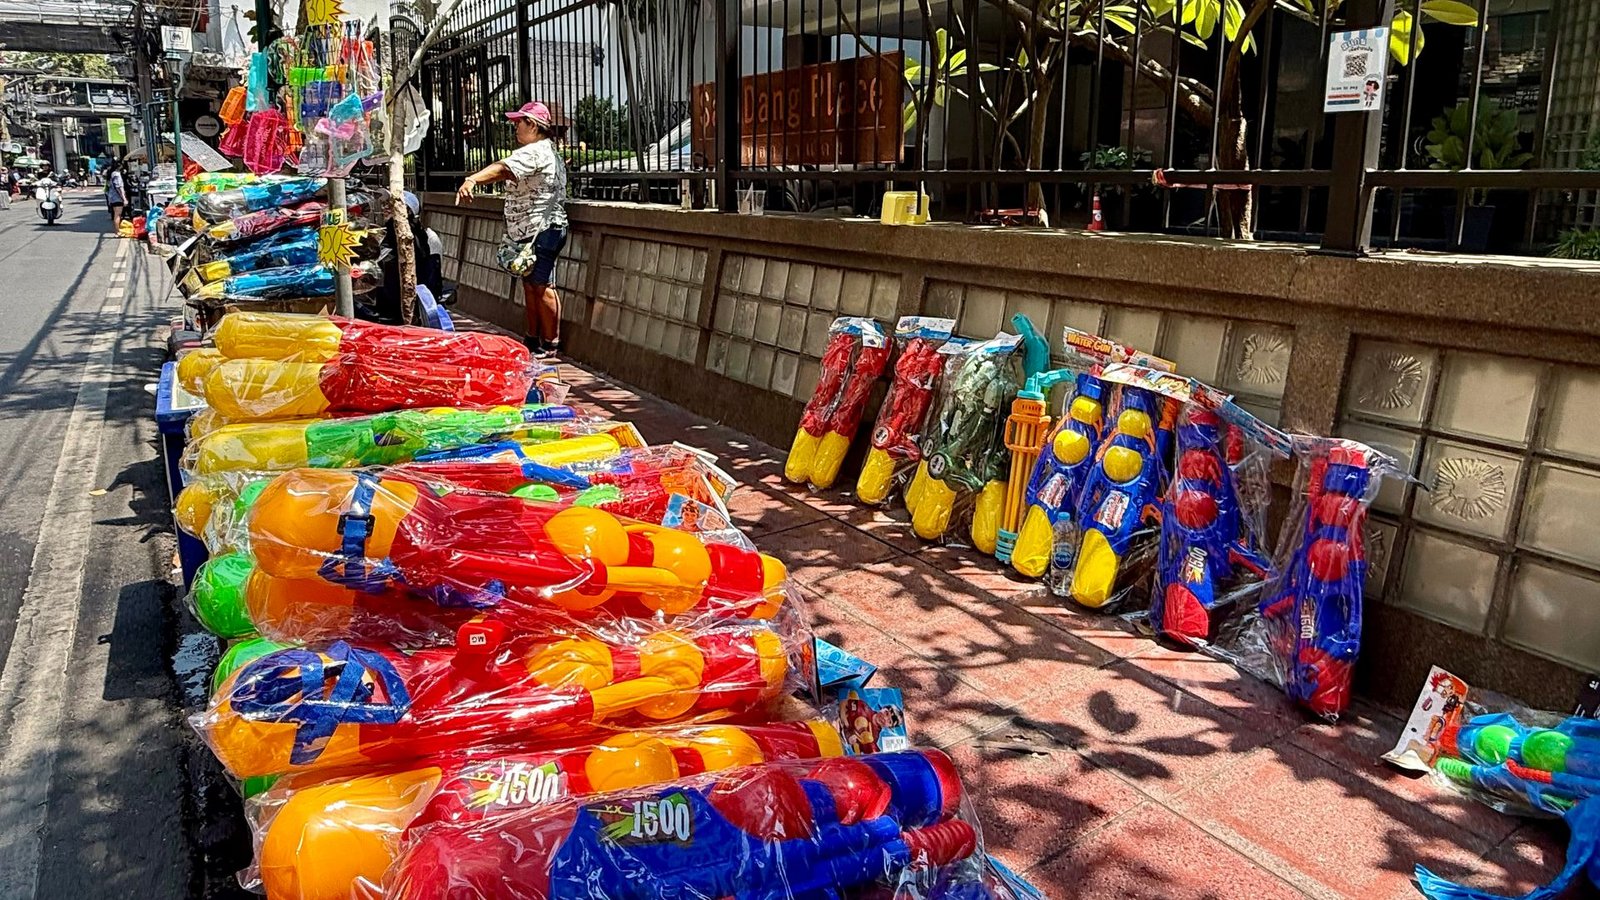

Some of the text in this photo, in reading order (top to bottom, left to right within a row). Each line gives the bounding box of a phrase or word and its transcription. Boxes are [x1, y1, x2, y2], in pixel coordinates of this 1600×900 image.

[744, 84, 801, 128] Dang
[1067, 332, 1092, 349] WATER
[1188, 546, 1208, 574] 1500
[1300, 614, 1313, 639] 1500
[495, 766, 558, 806] 1500
[630, 799, 691, 841] 1500
